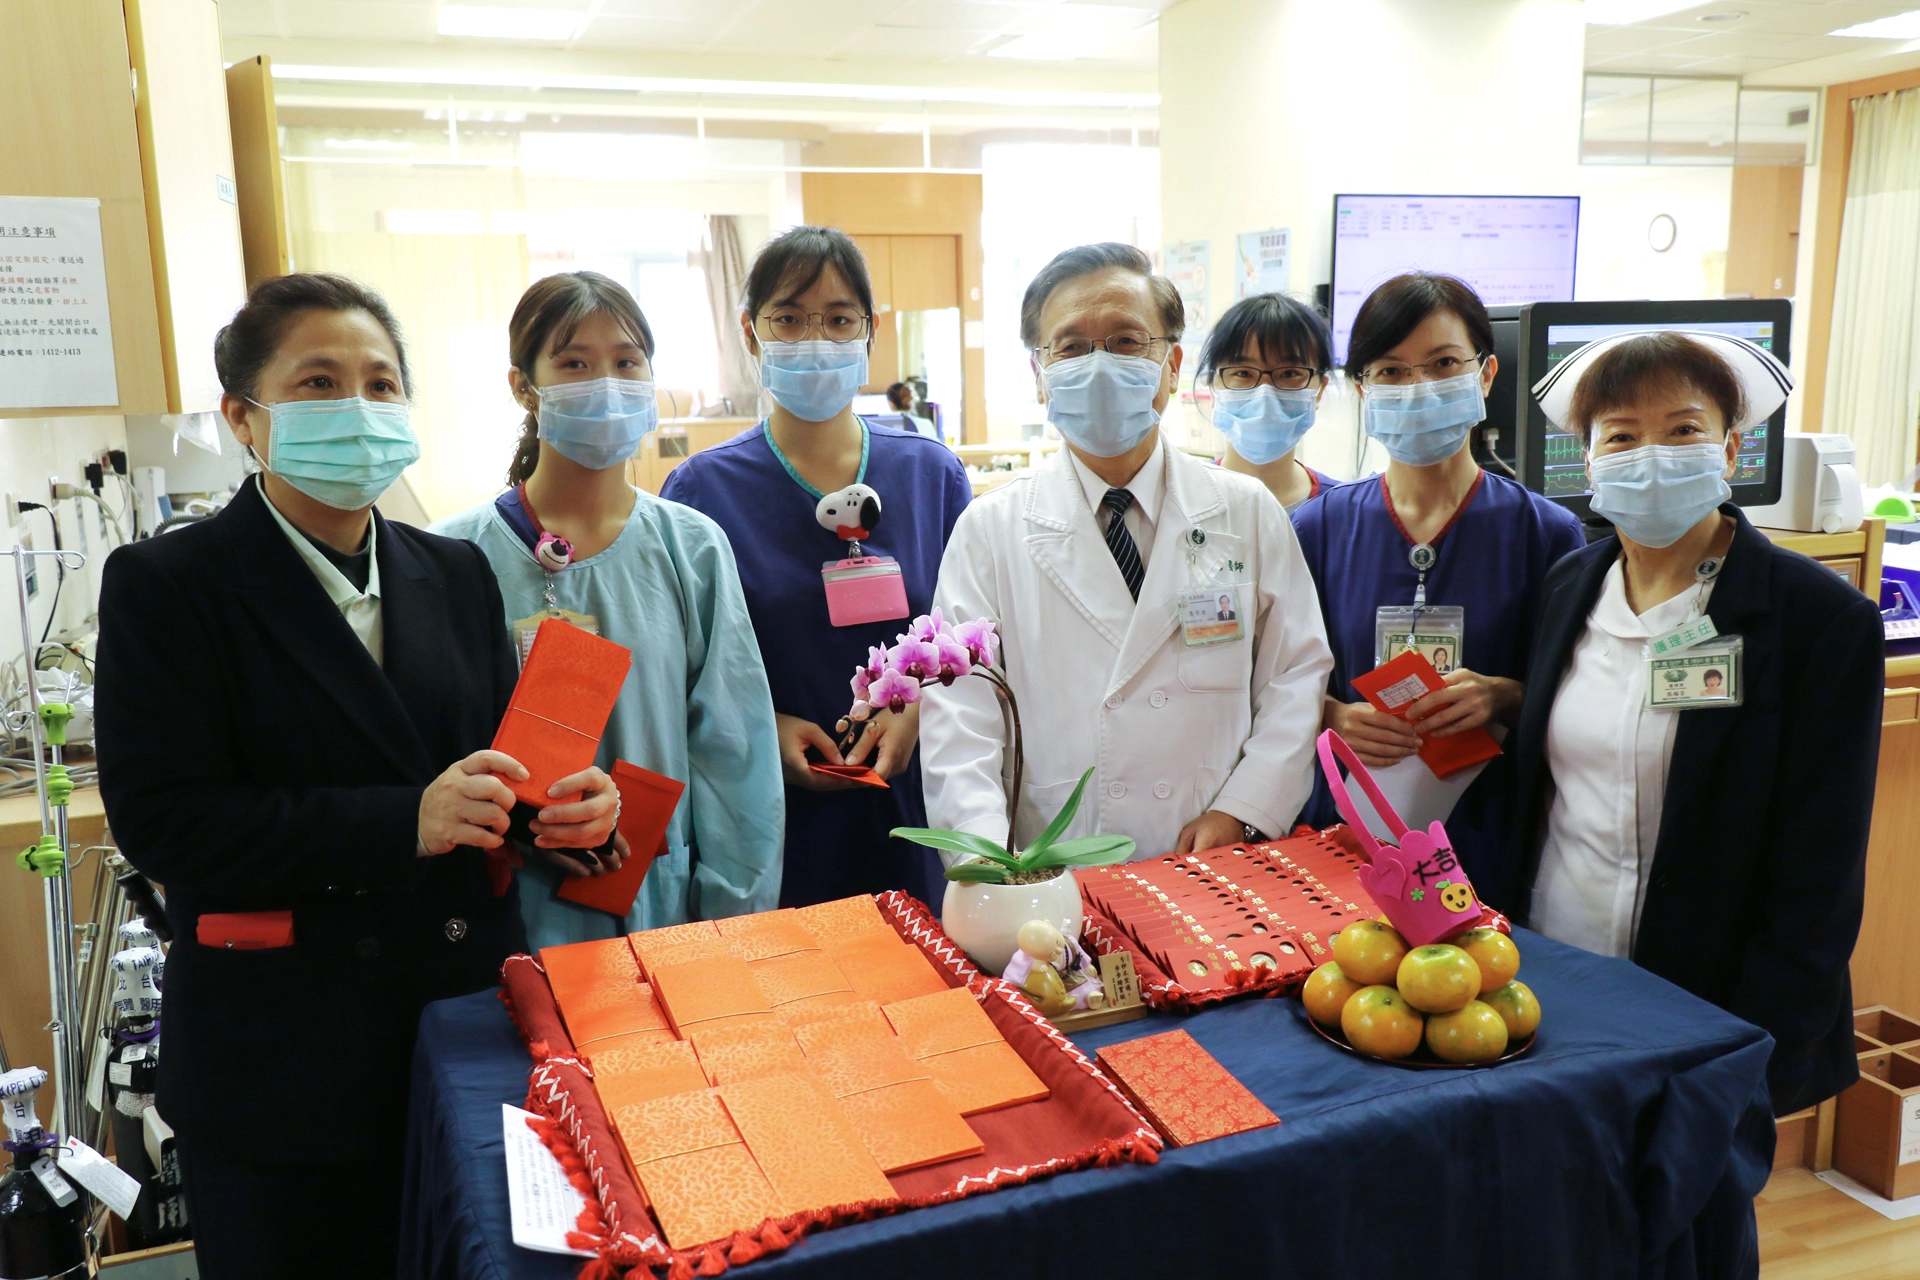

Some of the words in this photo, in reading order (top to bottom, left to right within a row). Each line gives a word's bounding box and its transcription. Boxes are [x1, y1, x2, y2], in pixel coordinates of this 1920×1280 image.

[0, 318, 90, 327] 無法處理，先關閉出口
[0, 327, 98, 336] 速通知中控室人員前來處
[1653, 622, 1712, 654] 護理主任
[1412, 847, 1457, 886] 大吉
[141, 974, 151, 989] 台
[14, 1101, 26, 1119] 台
